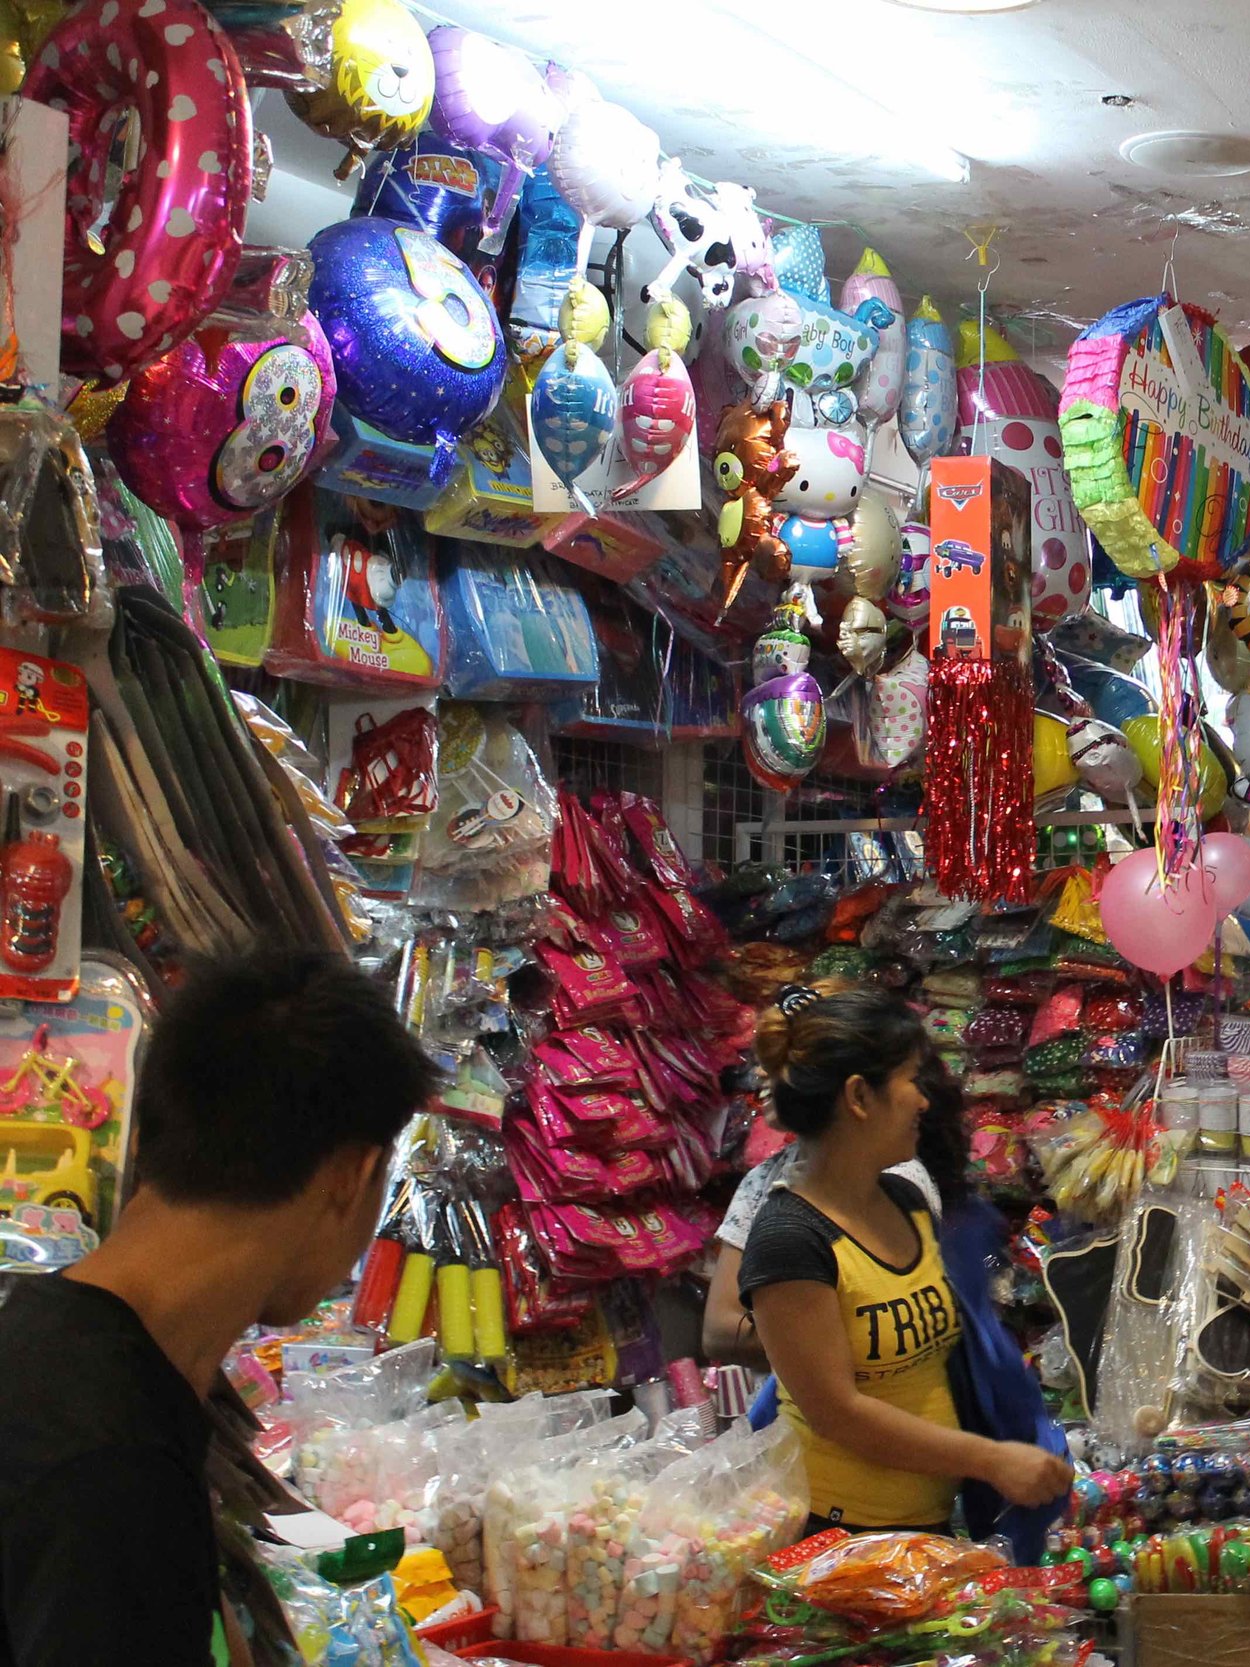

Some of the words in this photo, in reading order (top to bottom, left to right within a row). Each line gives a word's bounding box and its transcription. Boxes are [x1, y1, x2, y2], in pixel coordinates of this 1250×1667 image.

[801, 321, 826, 350] aby
[831, 329, 856, 361] Boy
[1129, 359, 1187, 429] Happy
[339, 622, 377, 649] Mickey
[350, 646, 388, 667] Mouse
